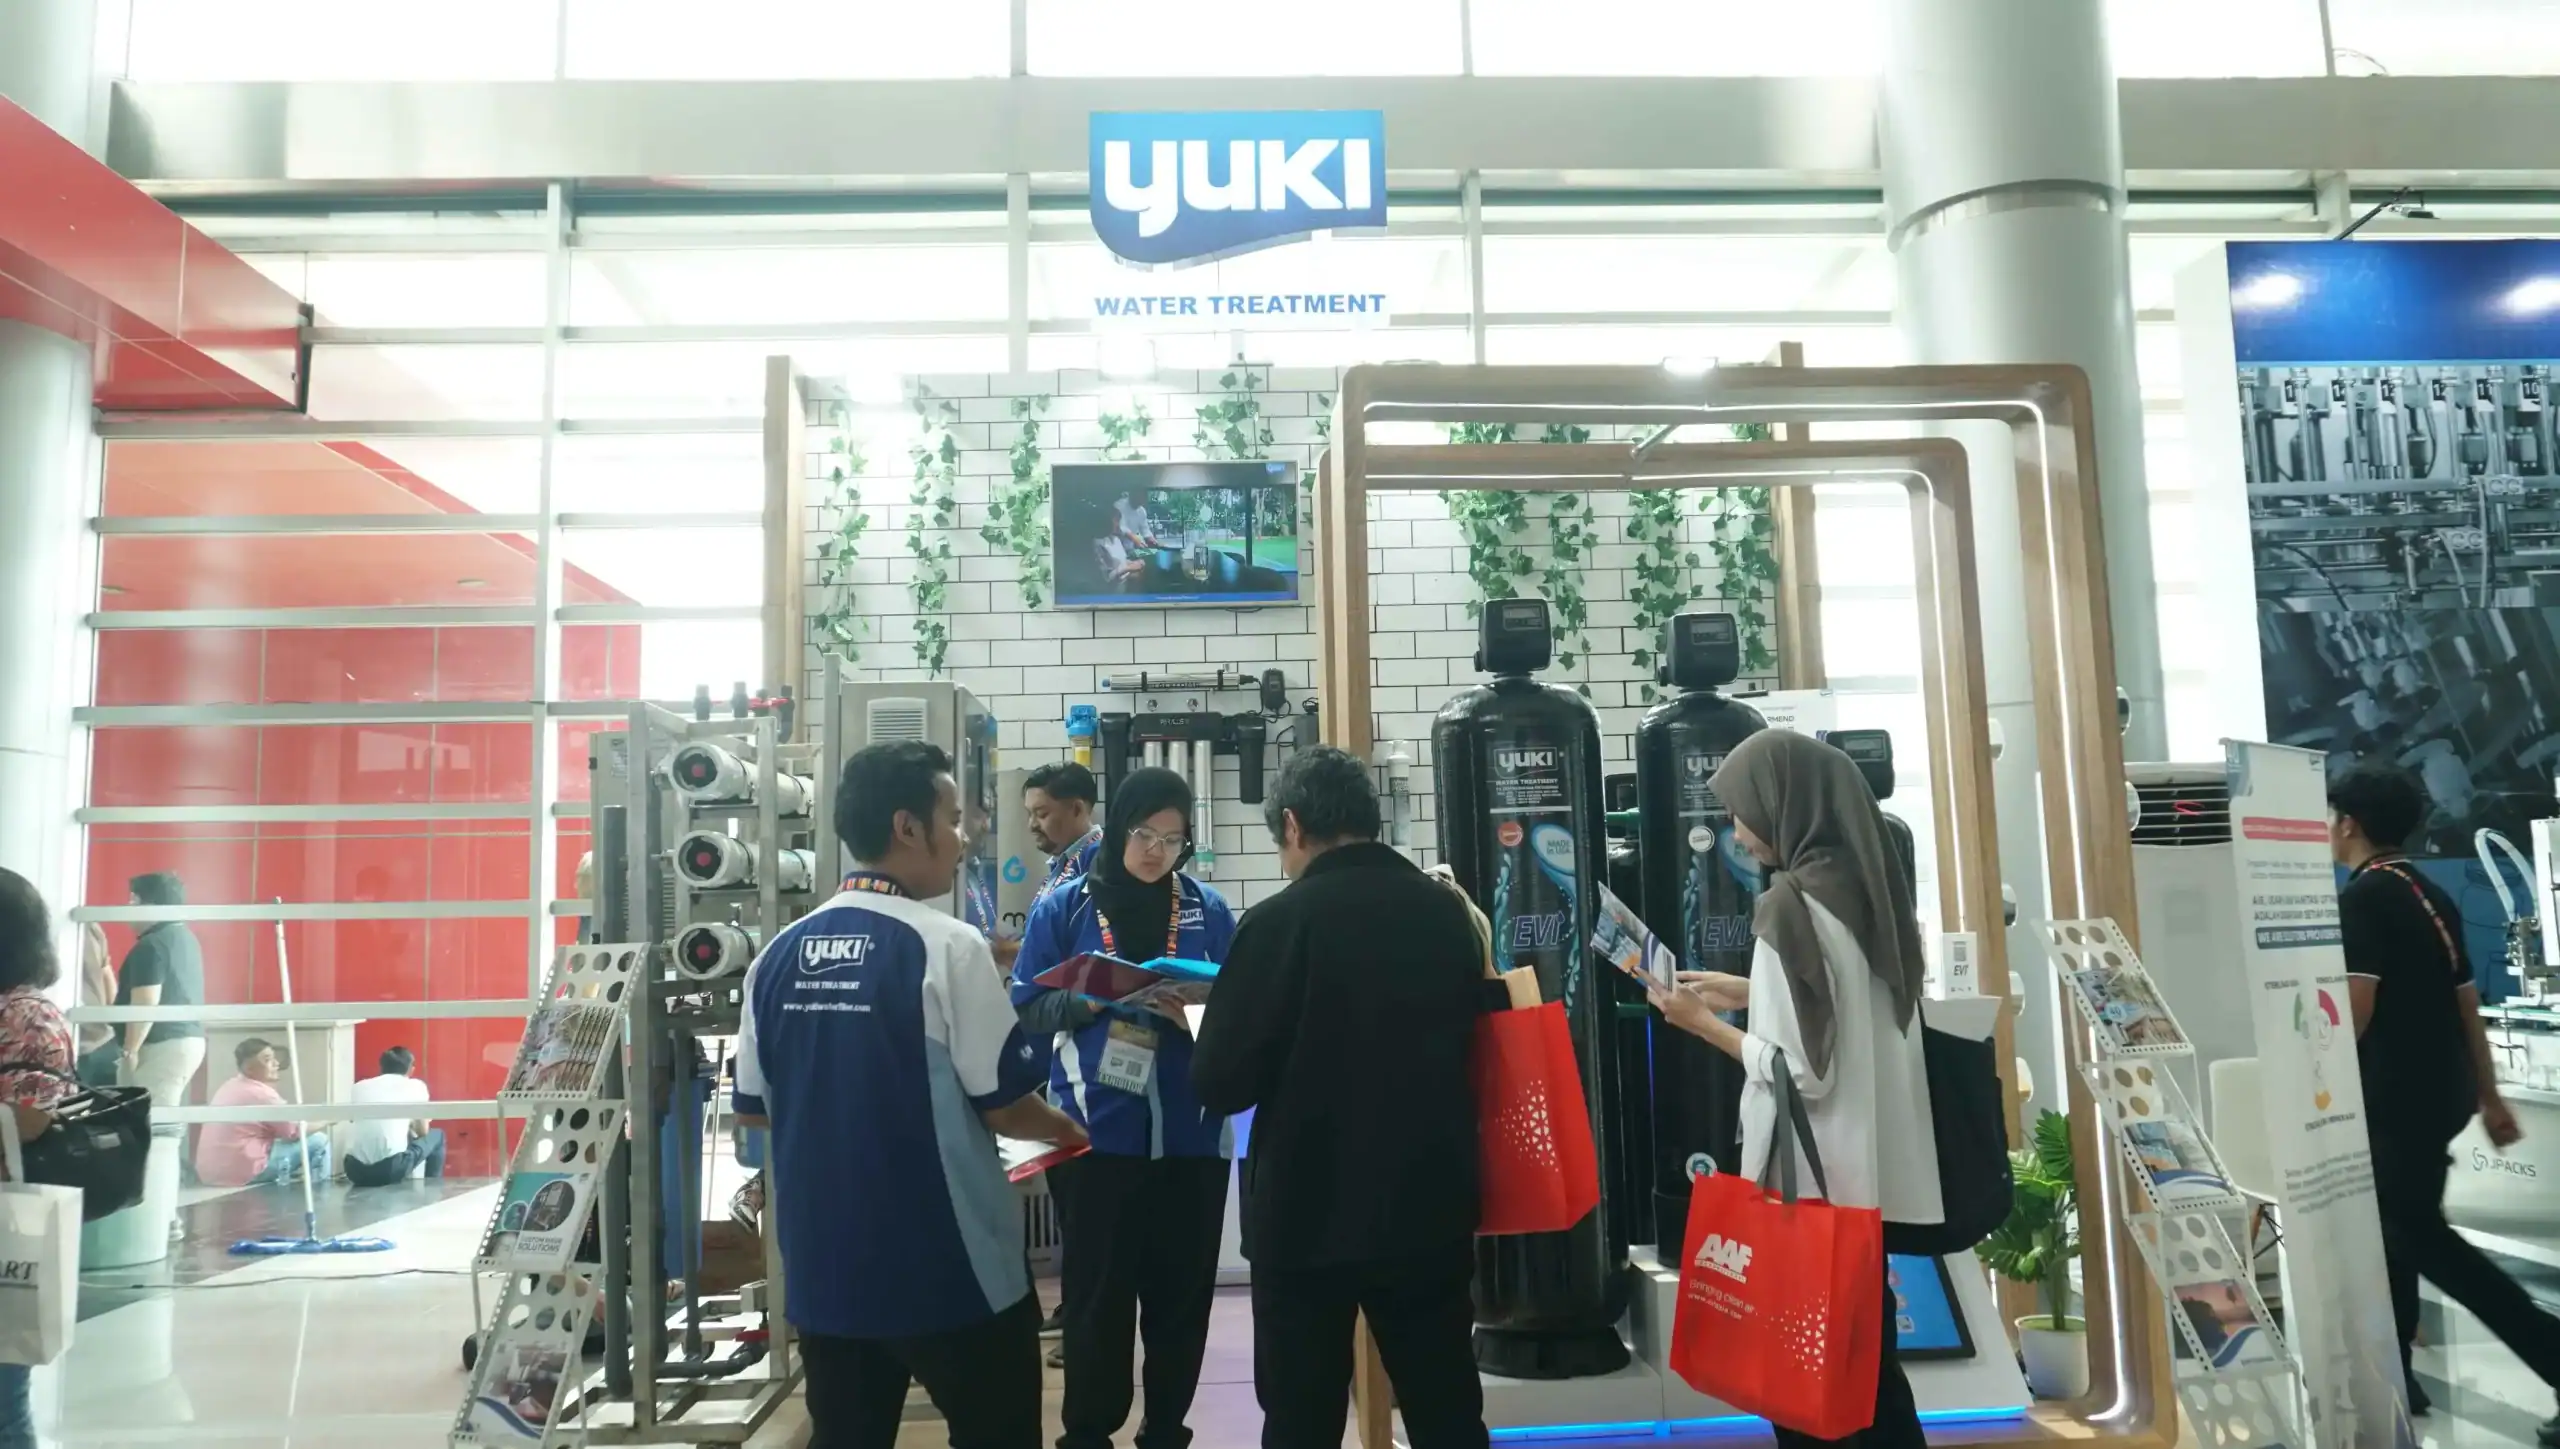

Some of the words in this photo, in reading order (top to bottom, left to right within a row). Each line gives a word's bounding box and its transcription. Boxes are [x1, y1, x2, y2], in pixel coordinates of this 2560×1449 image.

[1095, 296, 1198, 316] WATER
[1208, 294, 1386, 314] TREATMENT
[2524, 382, 2539, 396] 10
[795, 981, 820, 989] WATER
[821, 981, 860, 990] TREATMENT
[0, 1260, 39, 1280] RT
